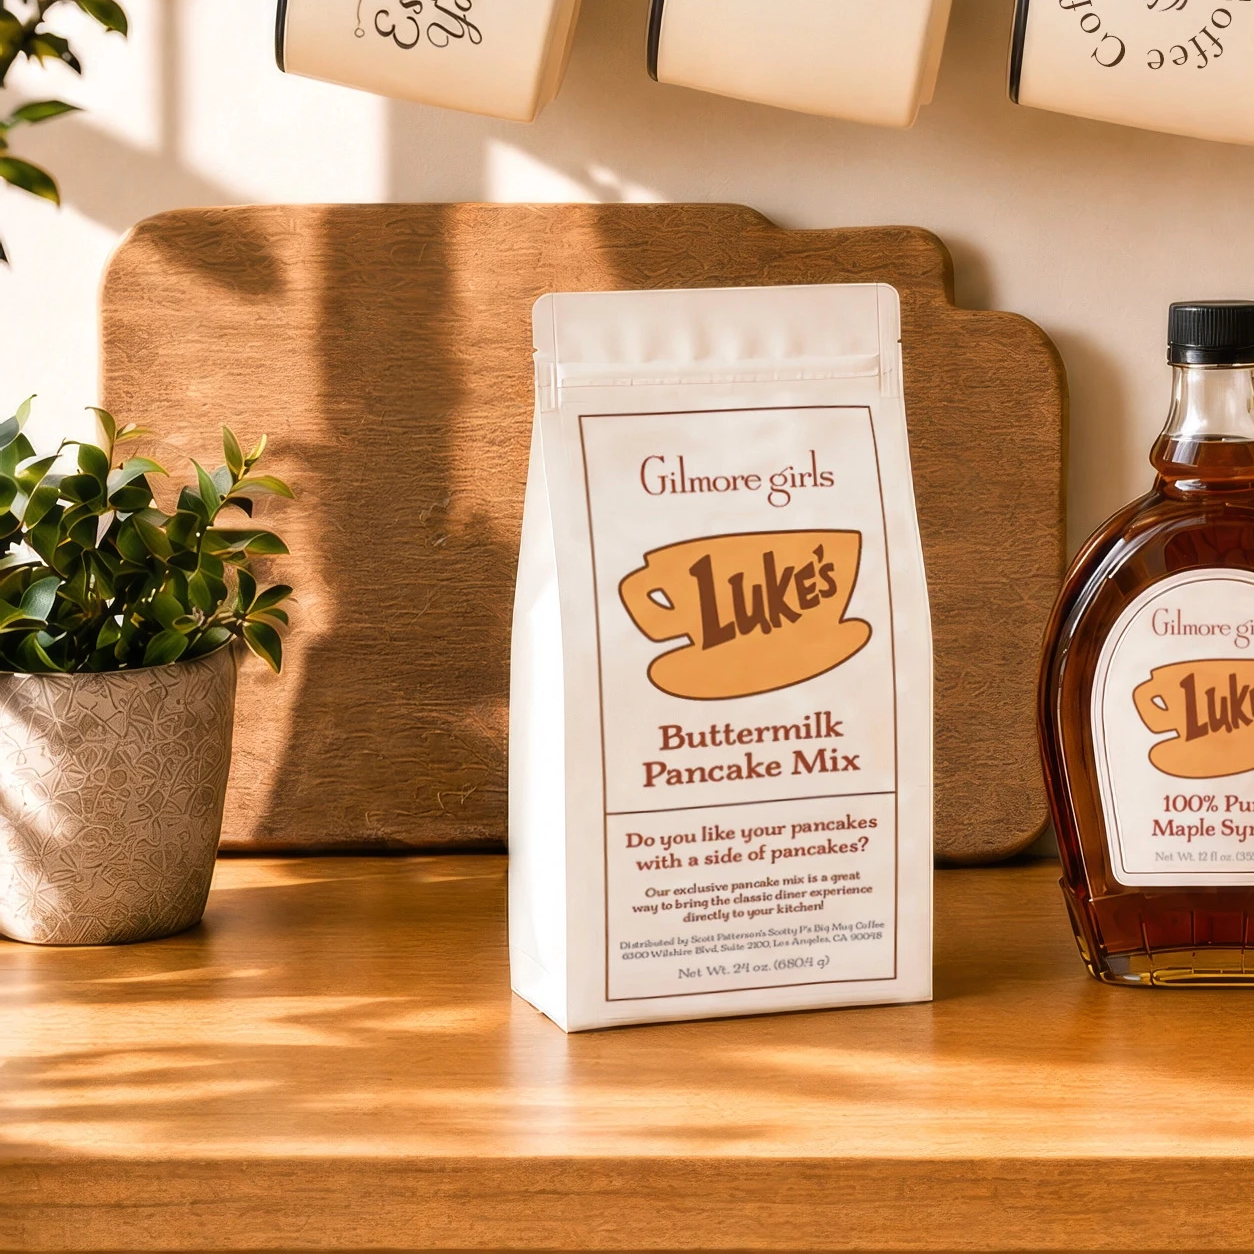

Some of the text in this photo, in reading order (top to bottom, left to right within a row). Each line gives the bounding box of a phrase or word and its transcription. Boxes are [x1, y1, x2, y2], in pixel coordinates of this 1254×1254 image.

[640, 450, 834, 506] Gilmore girls
[1152, 609, 1231, 636] Gilmore
[658, 711, 844, 751] Buttermilk
[643, 748, 860, 787] Pancake Mix
[1164, 795, 1218, 812] 100%
[626, 814, 877, 848] Do you like your pancakes
[1152, 818, 1215, 842] Maple
[636, 838, 869, 871] with a side of pancakes?
[1155, 852, 1173, 861] Net
[1177, 852, 1195, 861] Wt.
[1198, 851, 1207, 861] 12
[1211, 850, 1217, 862] fl
[645, 888, 671, 898] Our
[673, 883, 728, 895] exclusive
[731, 877, 779, 892] pancake
[783, 875, 804, 885] mix
[808, 874, 818, 883] is
[831, 872, 860, 884] great
[632, 886, 872, 913] way to bring the classic diner experience
[683, 901, 823, 922] directly to your kitchen!
